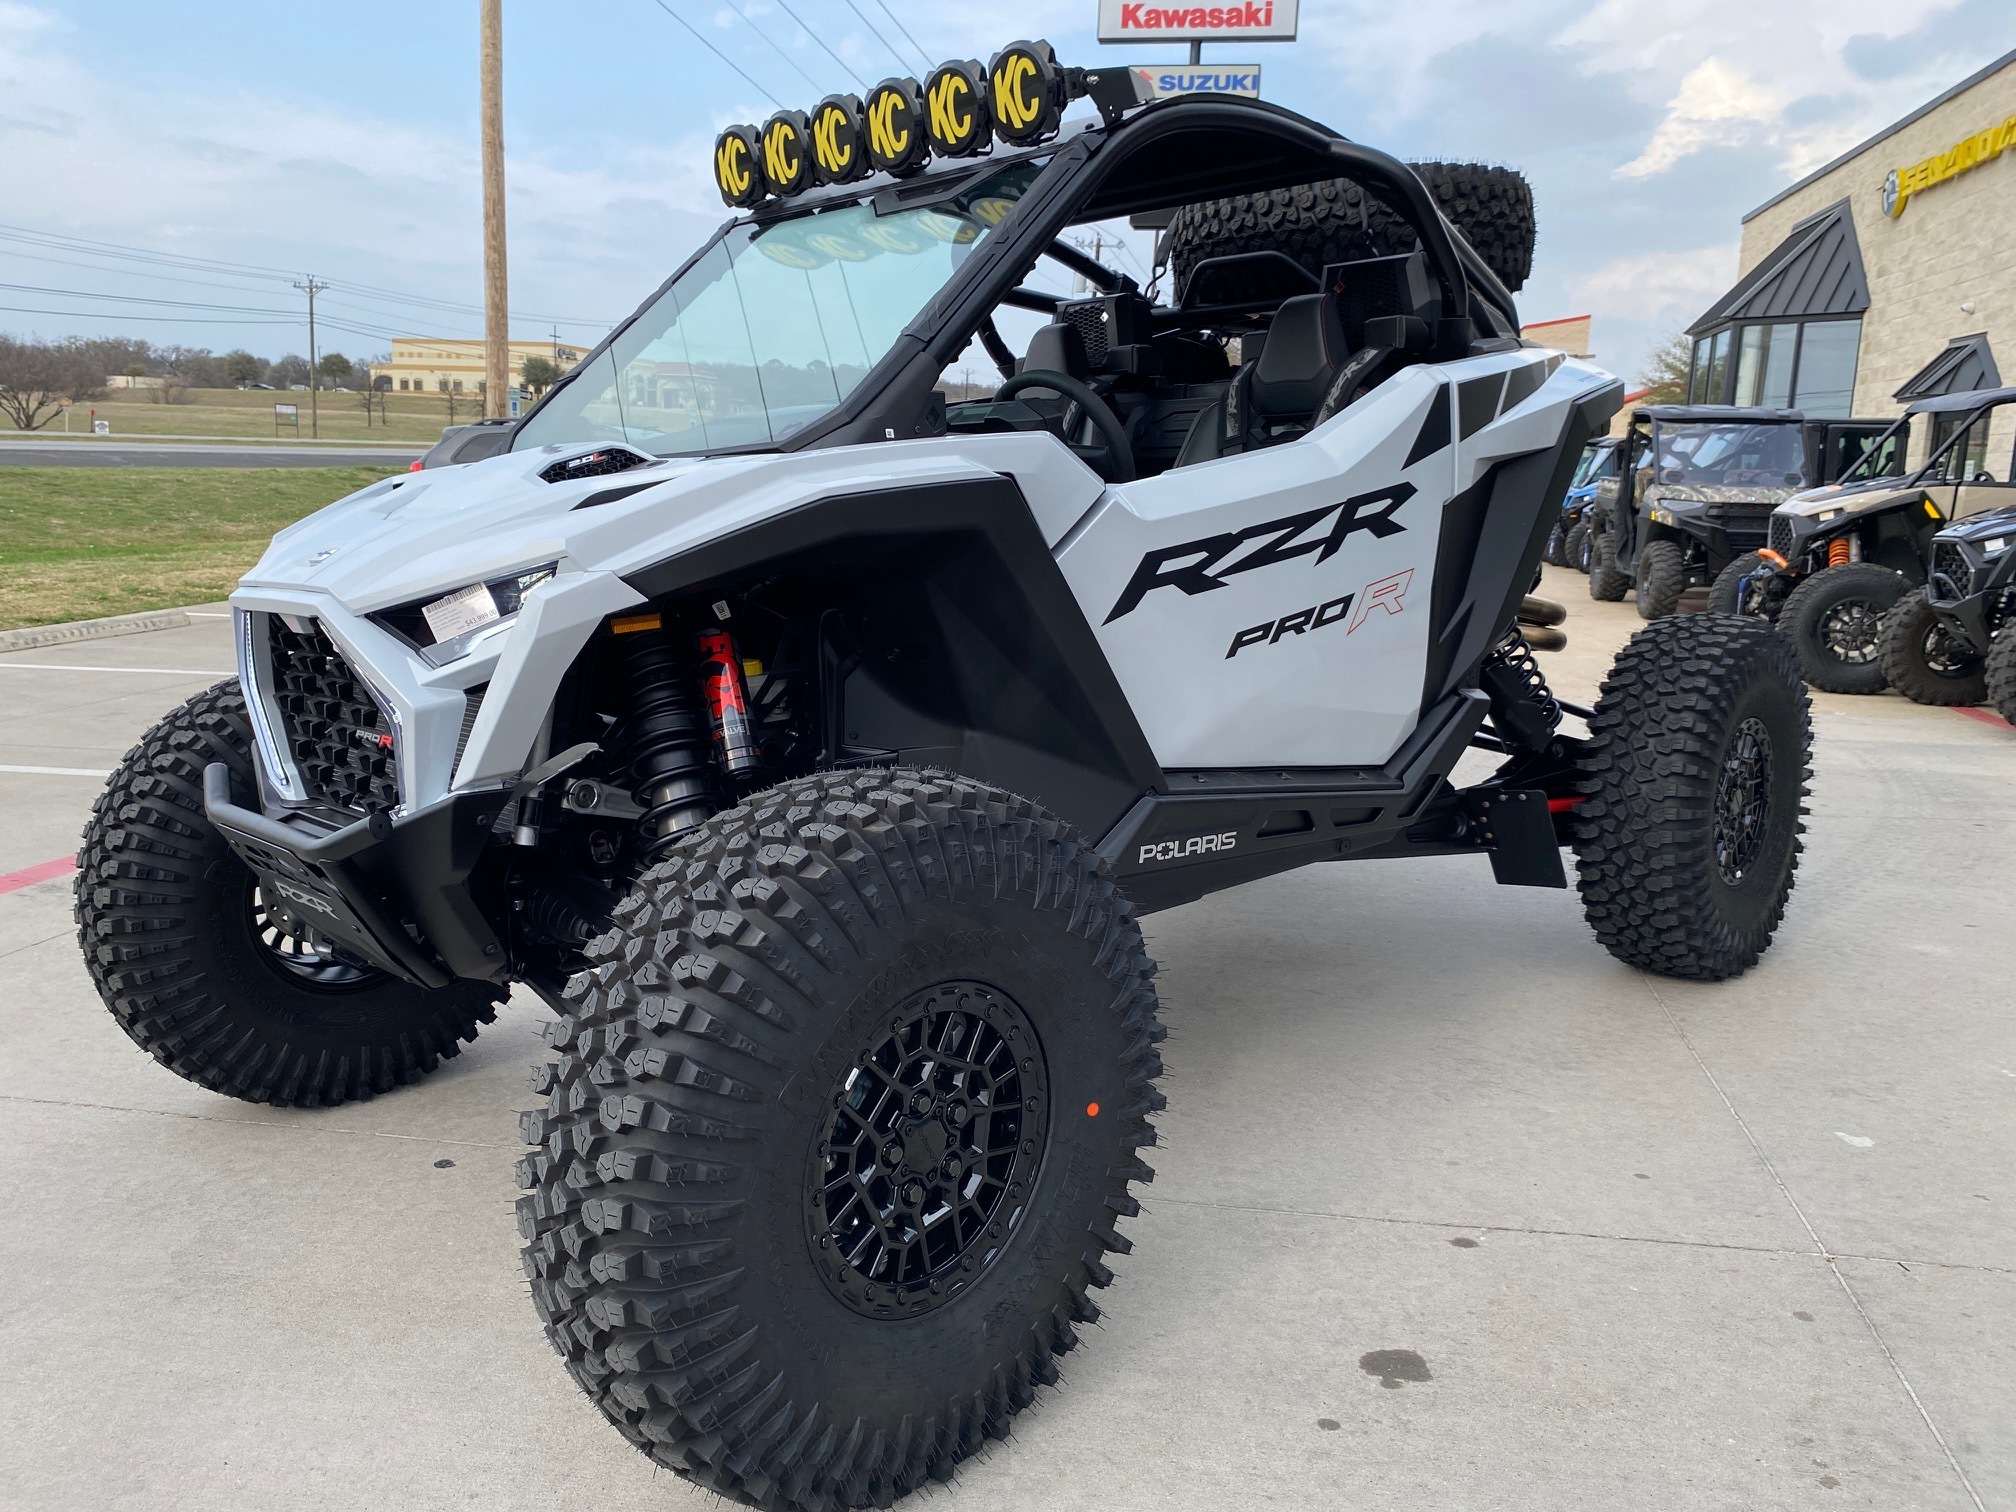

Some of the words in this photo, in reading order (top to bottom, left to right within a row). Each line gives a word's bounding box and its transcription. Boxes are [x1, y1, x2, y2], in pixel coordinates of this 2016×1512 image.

[1121, 1, 1273, 29] Kawasaki
[928, 73, 971, 144] KC
[993, 54, 1039, 129] KC
[1158, 74, 1258, 92] SUZUKI
[764, 122, 798, 185] KC
[812, 106, 850, 172] KC
[868, 90, 908, 159] KC
[717, 136, 750, 196] KC
[1101, 481, 1418, 627] RZR
[1225, 592, 1355, 660] PRO
[1138, 831, 1238, 864] POLARIS
